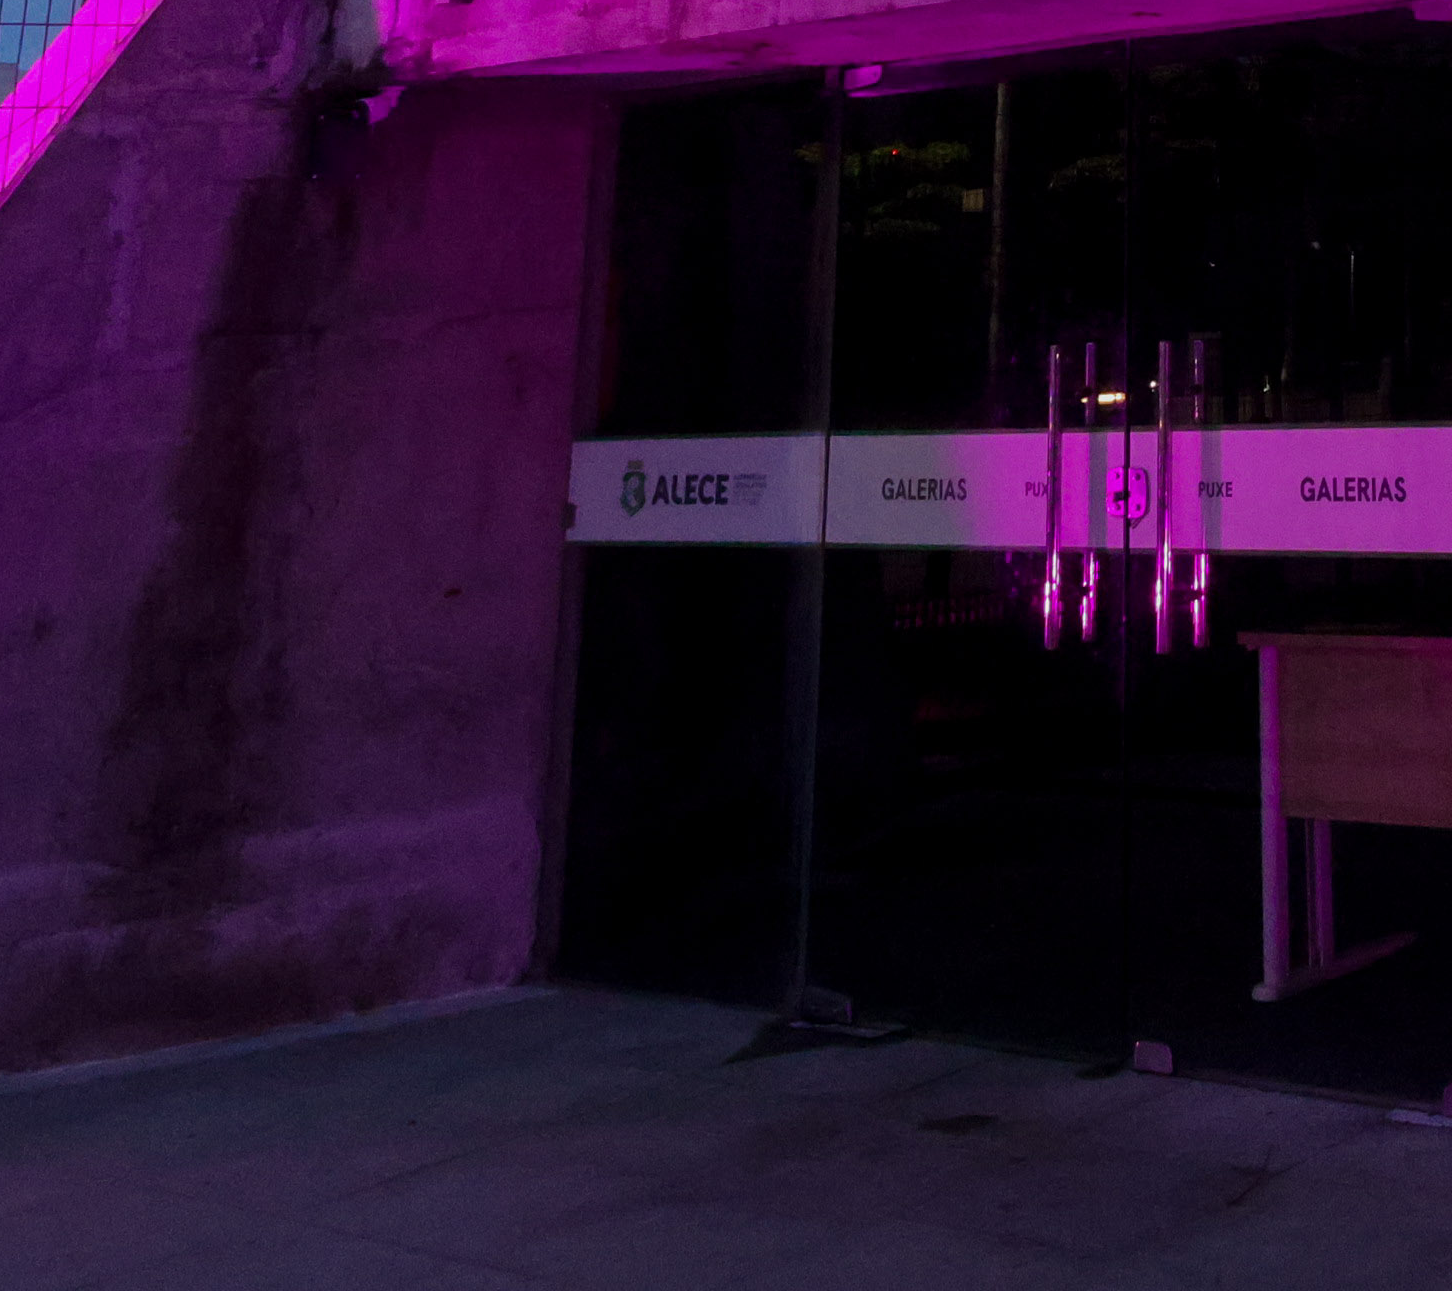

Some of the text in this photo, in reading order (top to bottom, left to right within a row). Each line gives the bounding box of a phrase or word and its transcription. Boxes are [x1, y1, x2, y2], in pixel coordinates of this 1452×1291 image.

[651, 474, 730, 506] ALECE
[881, 477, 968, 501] GALERIAS
[1024, 481, 1048, 497] PUX
[1198, 481, 1234, 498] PUXE
[1300, 476, 1407, 503] GALERIAS
